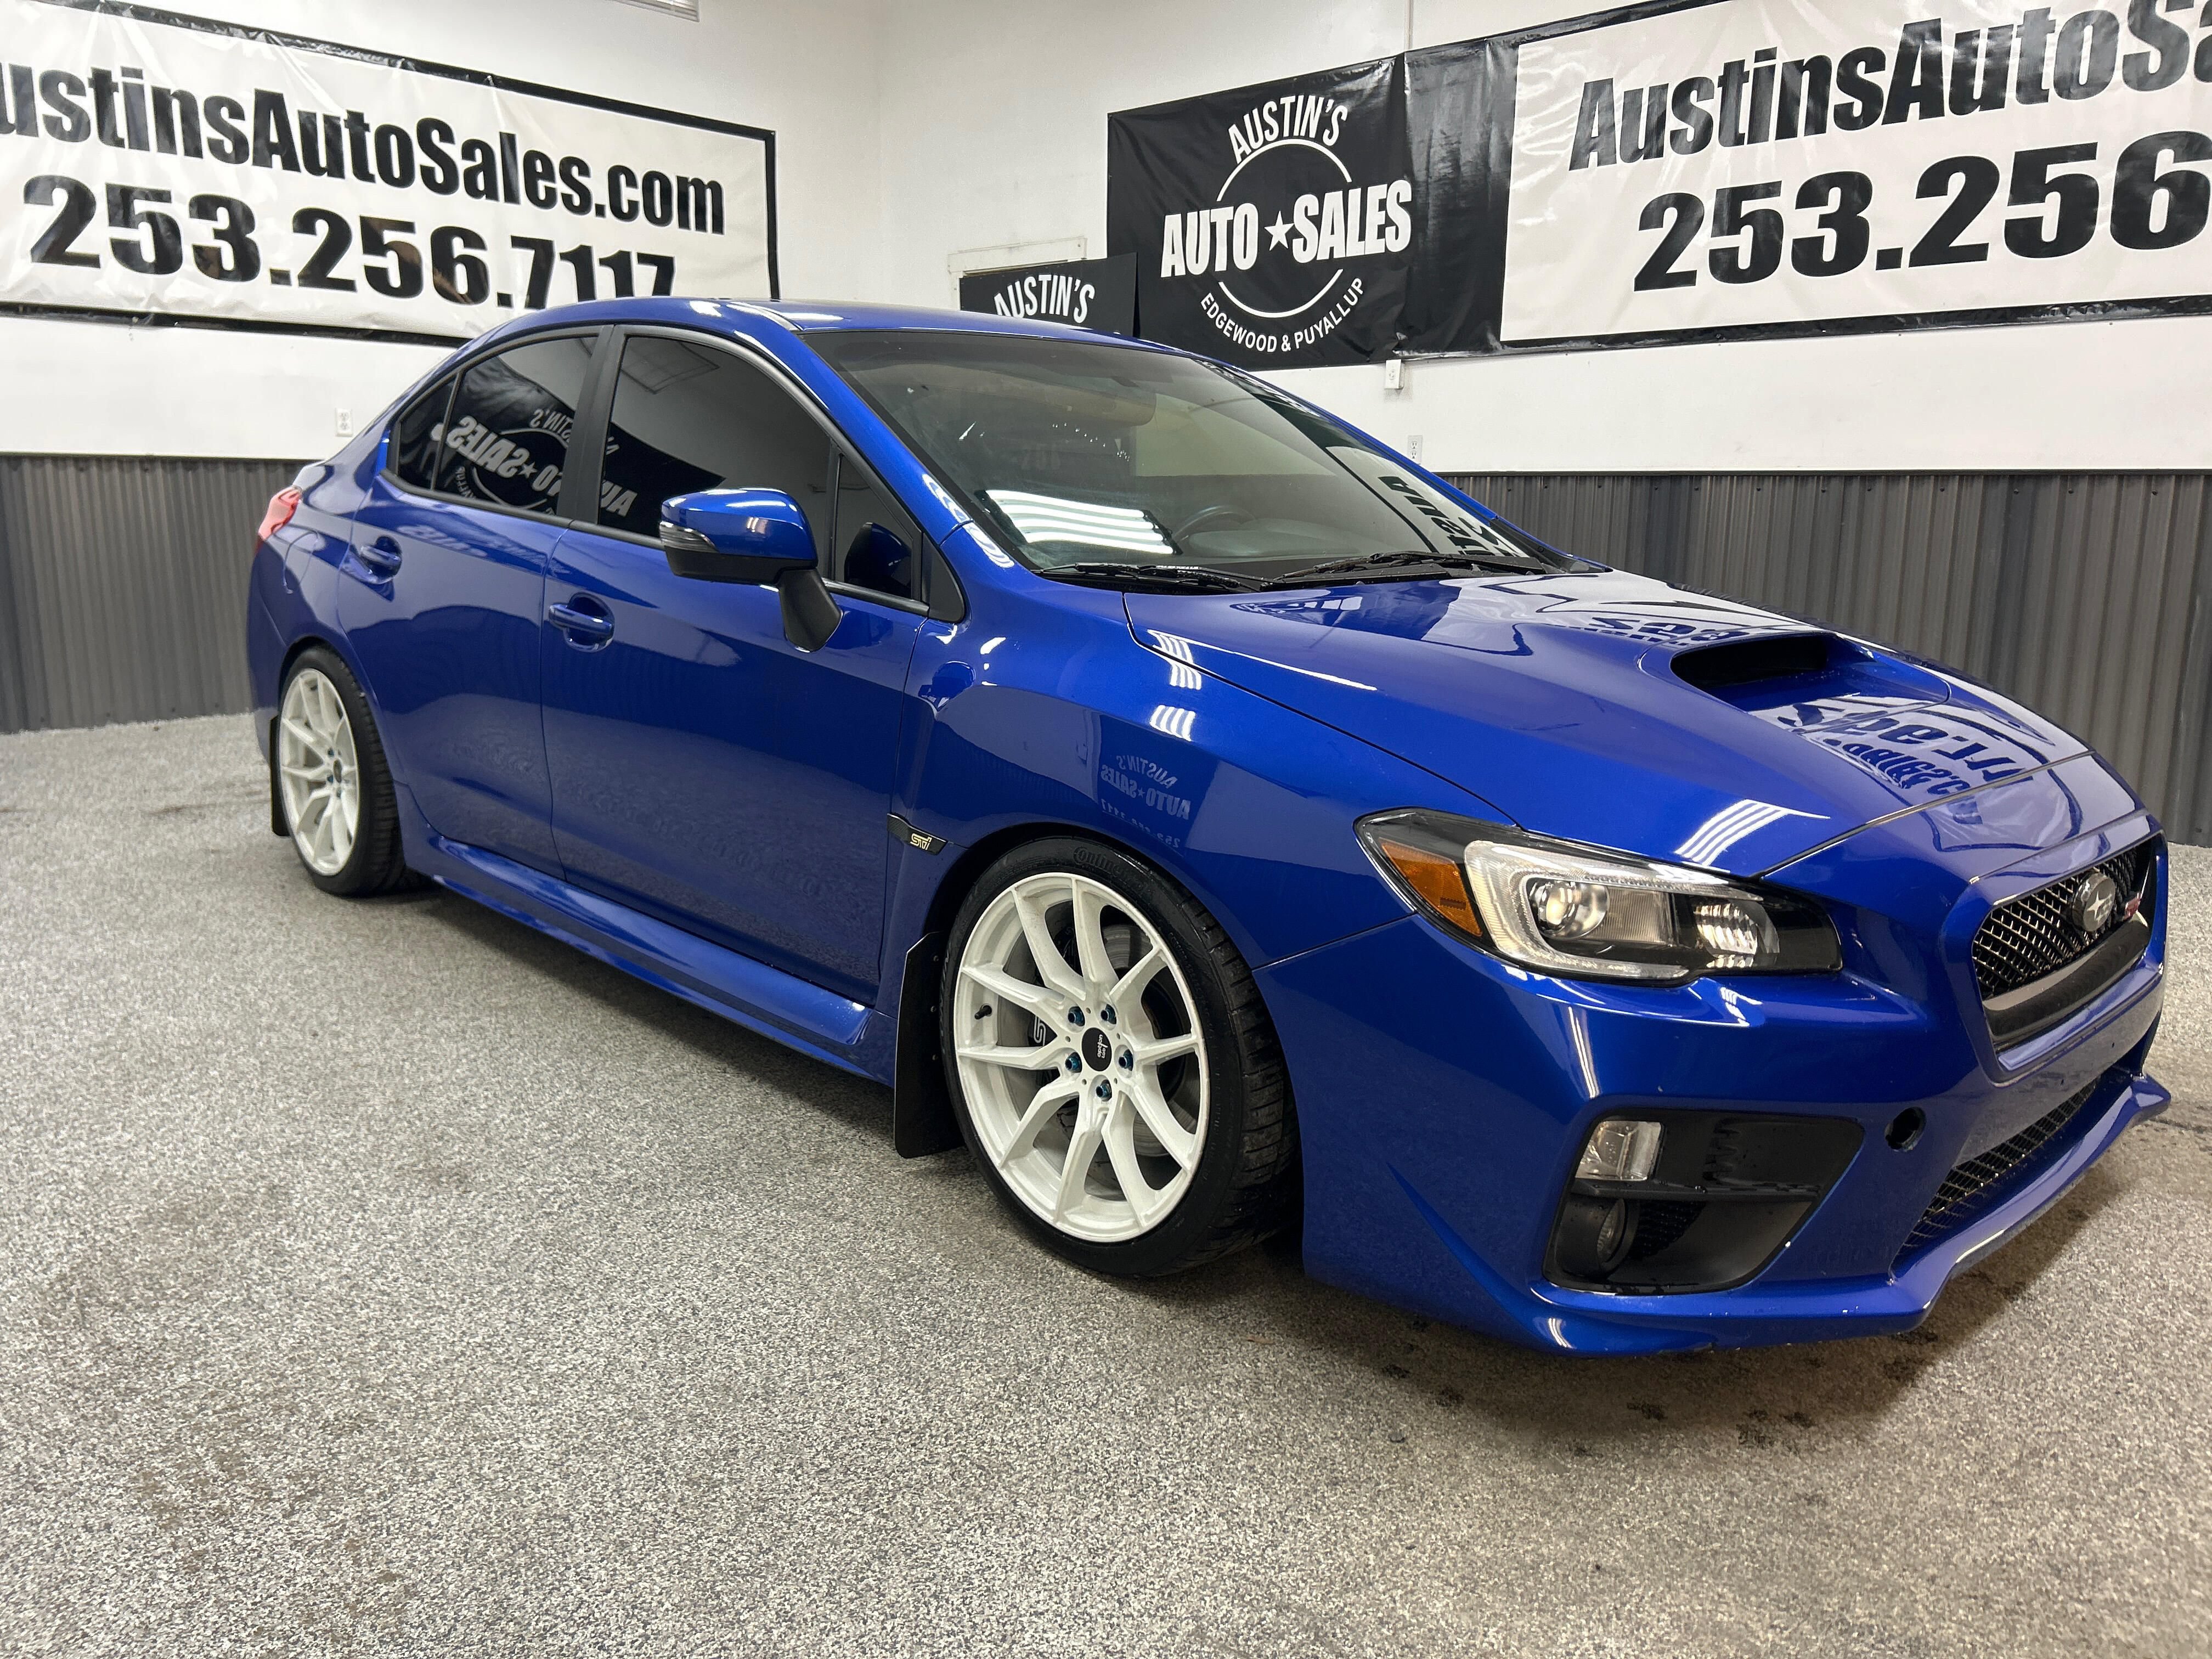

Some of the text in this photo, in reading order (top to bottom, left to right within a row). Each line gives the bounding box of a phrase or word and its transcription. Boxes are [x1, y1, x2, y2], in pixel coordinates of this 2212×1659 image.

[1228, 95, 1347, 163] AUSTIN'S
[23, 175, 675, 309] 253.256.7117
[1160, 179, 1412, 278] AUTO SALES
[994, 274, 1095, 323] AUSTIN'S
[1200, 278, 1363, 352] EDGEWOOD & PUYALLUP
